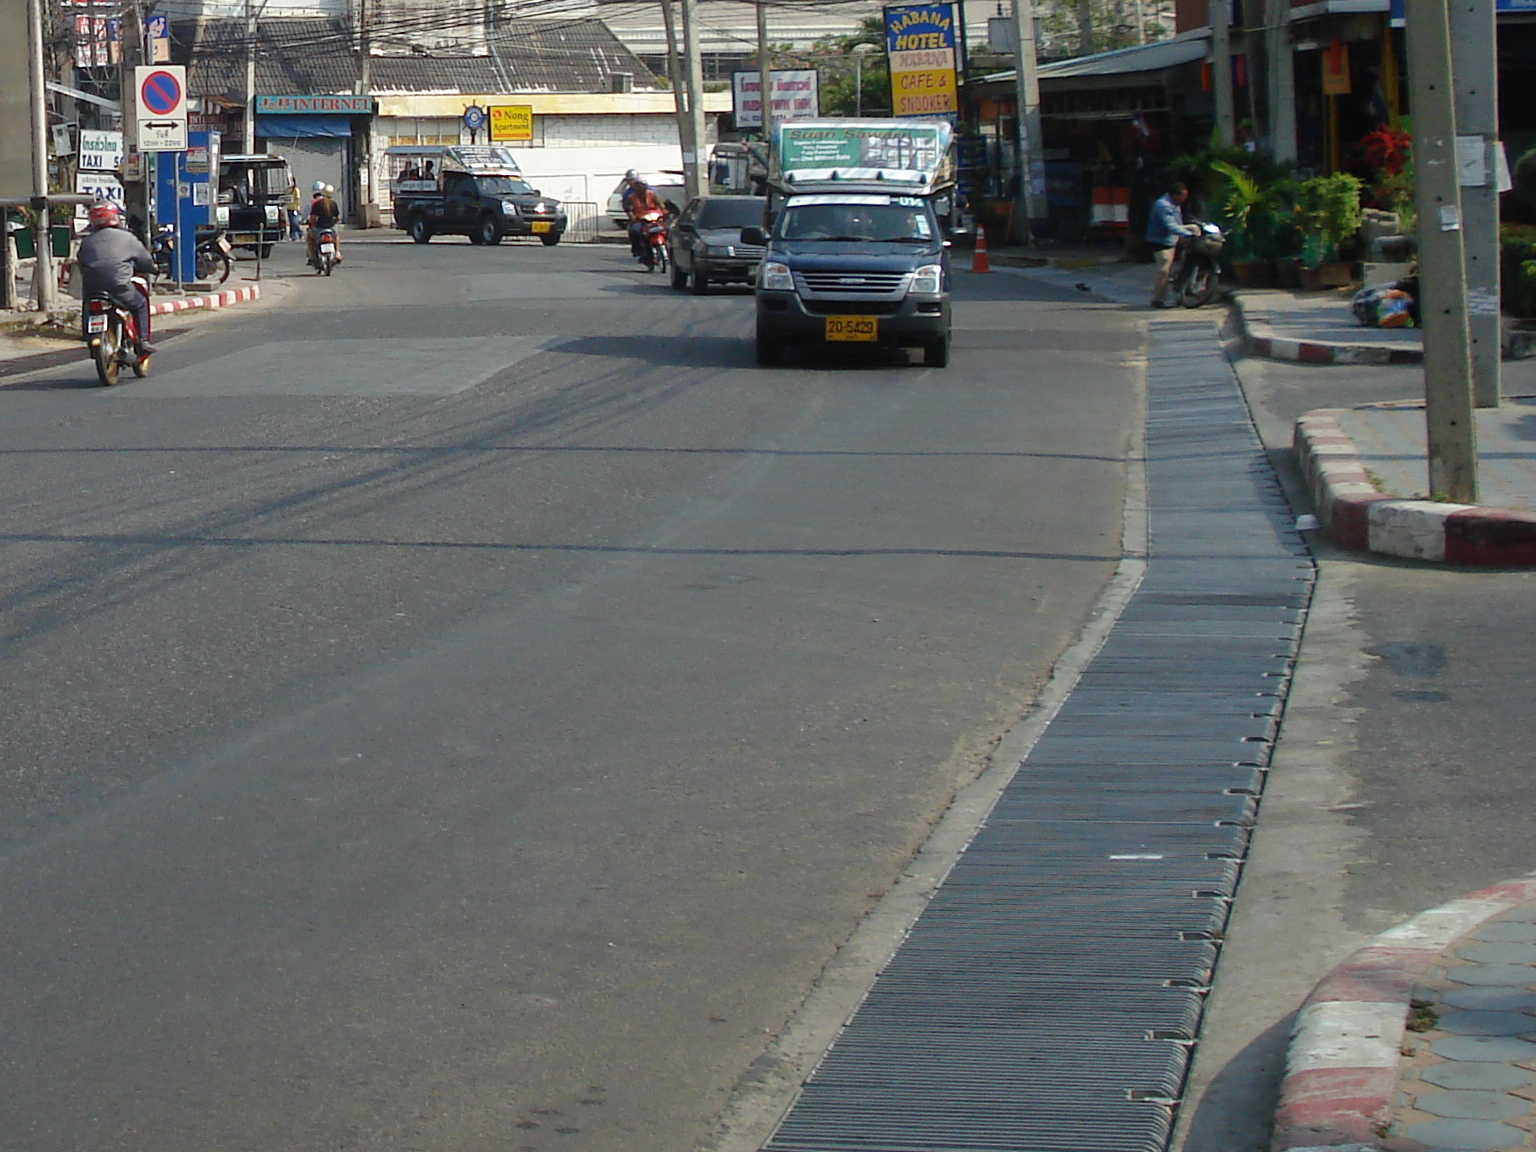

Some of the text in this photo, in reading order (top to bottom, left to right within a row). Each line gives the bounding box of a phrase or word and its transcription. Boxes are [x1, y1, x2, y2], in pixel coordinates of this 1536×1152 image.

[890, 11, 951, 34] HABANA
[896, 33, 947, 50] HOTEL
[901, 71, 947, 90] CAFE &
[293, 98, 371, 110] INTERNET
[900, 94, 951, 112] SNOOKER
[504, 110, 529, 124] Nong
[493, 123, 530, 134] Apartment
[790, 130, 835, 139] Suan
[82, 155, 102, 168] TAXI
[82, 187, 122, 201] TAXI
